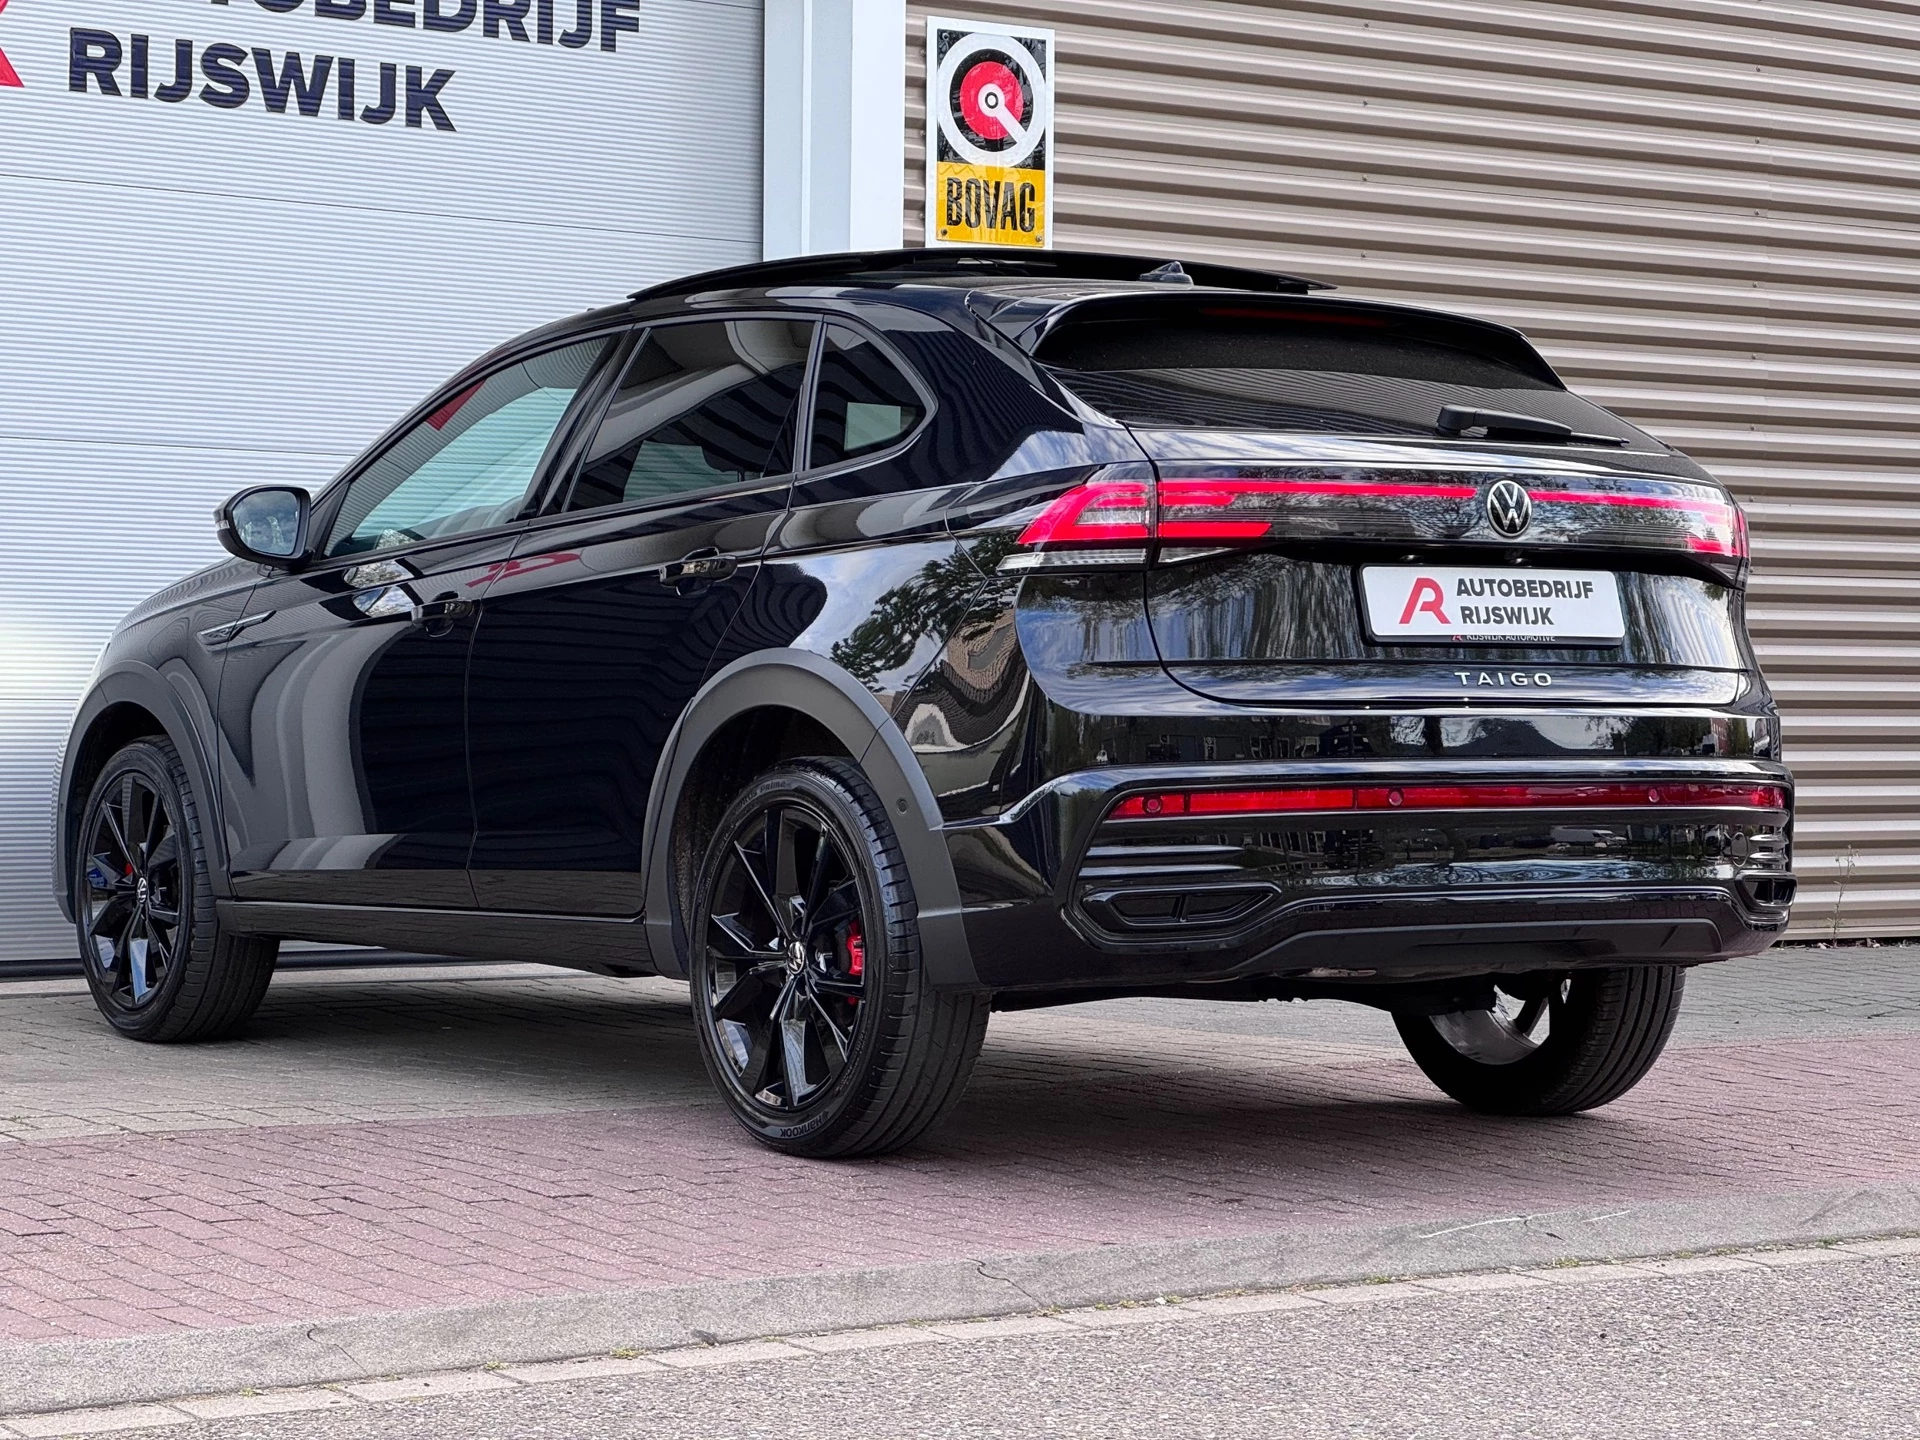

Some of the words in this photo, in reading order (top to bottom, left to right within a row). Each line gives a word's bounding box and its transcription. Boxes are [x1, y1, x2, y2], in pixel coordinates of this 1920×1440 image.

[68, 27, 457, 132] RIJSWIJK
[946, 177, 1036, 233] BOVAG
[1456, 578, 1594, 599] AUTOBEDRIJF
[1460, 606, 1555, 626] RIJSWIJK
[1454, 671, 1552, 687] TAIGO
